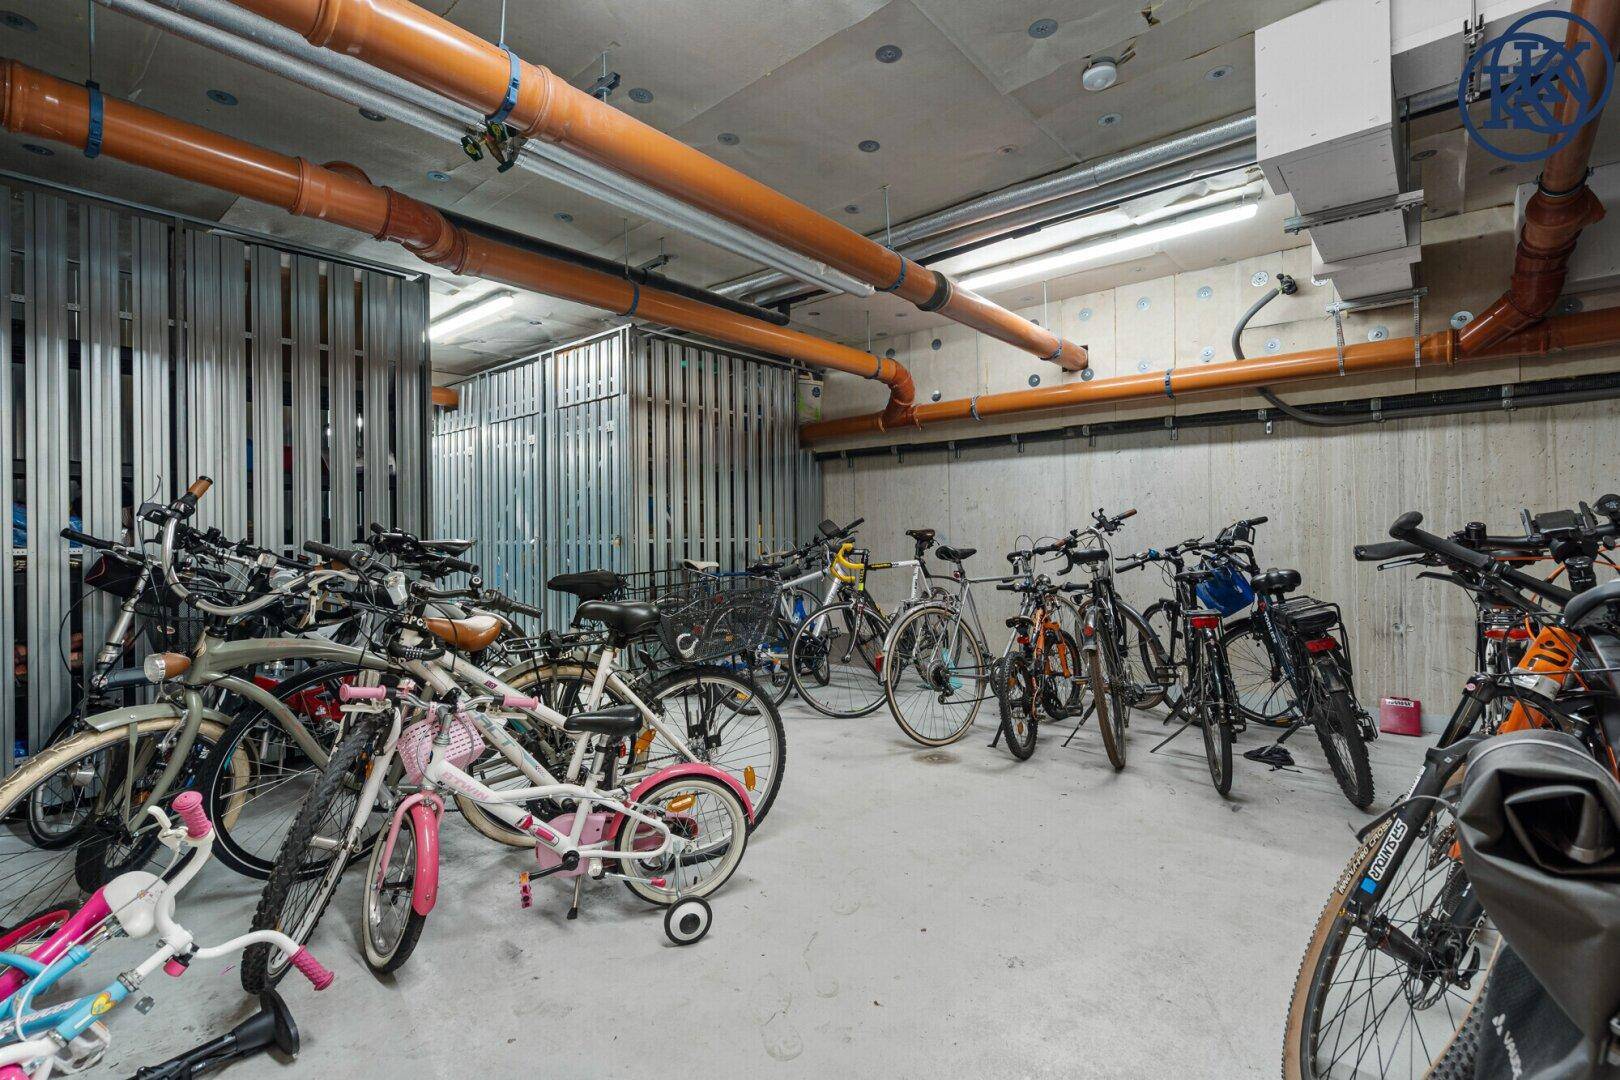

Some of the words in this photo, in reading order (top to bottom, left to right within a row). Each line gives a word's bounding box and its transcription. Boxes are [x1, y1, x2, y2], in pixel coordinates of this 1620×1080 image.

[1369, 818, 1393, 847] CROSS
[1392, 820, 1406, 840] SR
[1370, 837, 1396, 879] SUNTOUR
